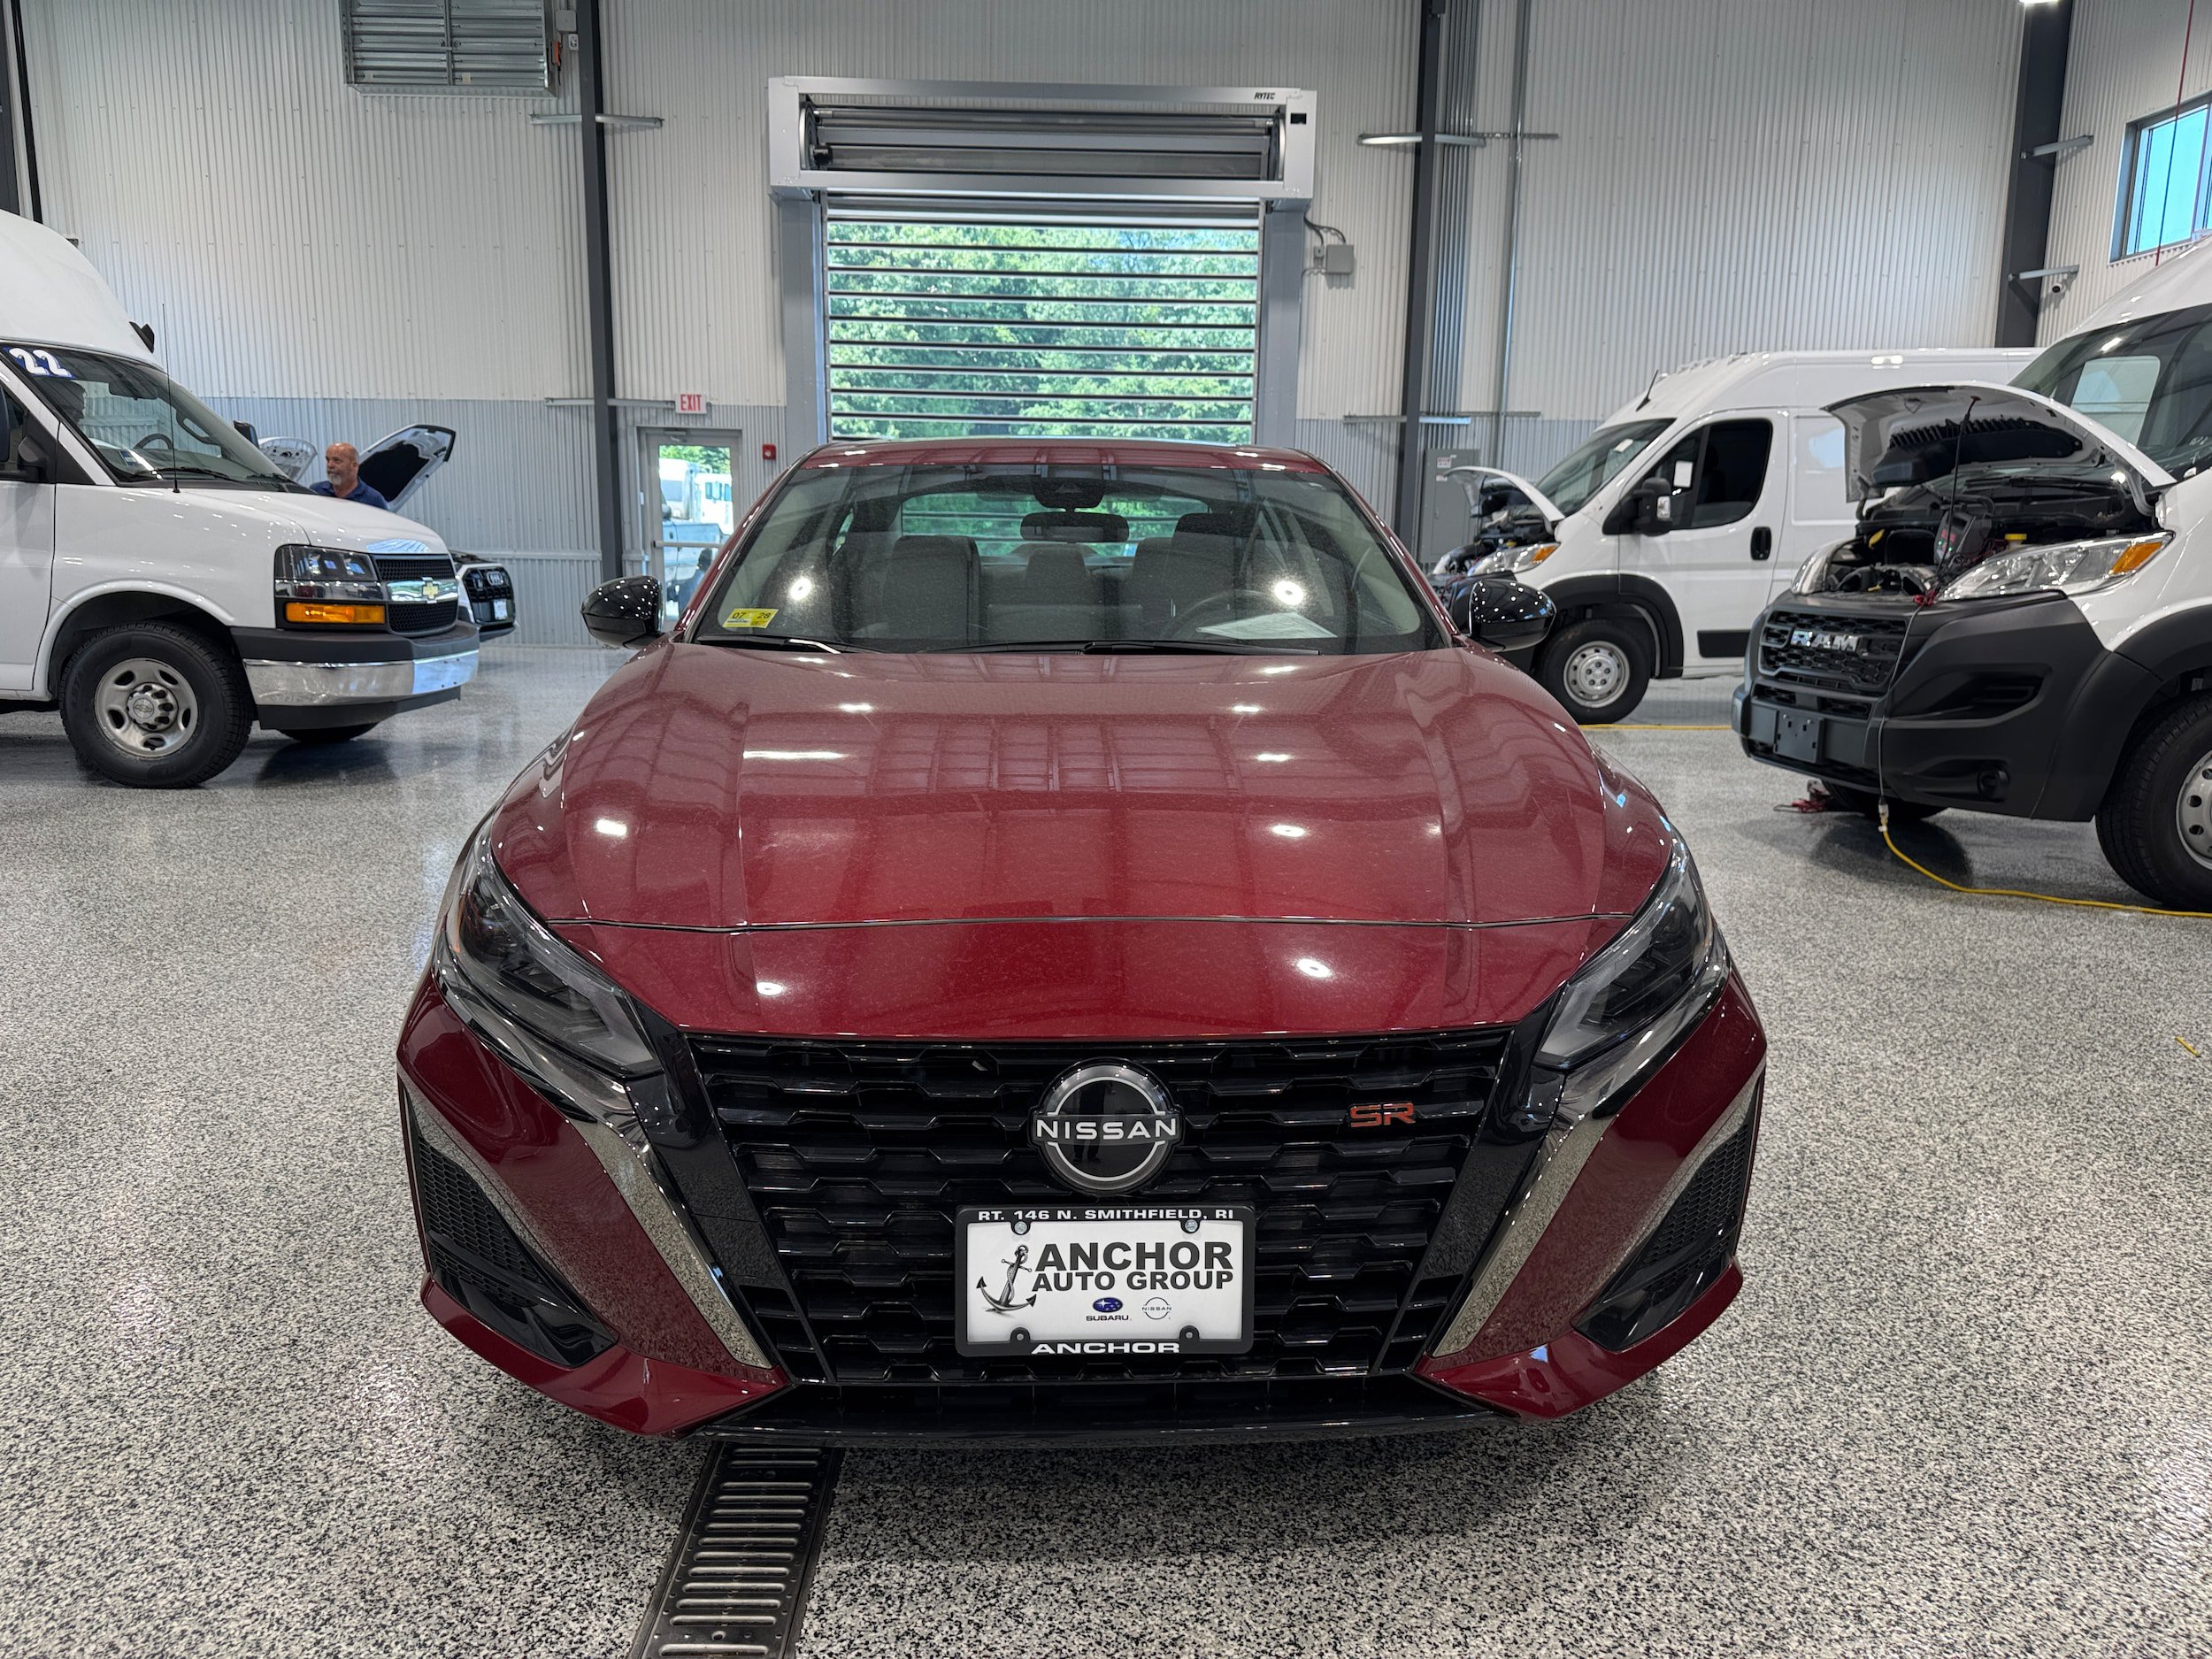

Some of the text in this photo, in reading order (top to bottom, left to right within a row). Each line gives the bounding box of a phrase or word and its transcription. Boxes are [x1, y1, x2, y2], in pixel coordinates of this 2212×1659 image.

[9, 348, 73, 376] 22
[680, 394, 702, 411] EXIT
[1790, 630, 1859, 651] RAM
[1349, 1102, 1416, 1128] SR
[1036, 1118, 1176, 1140] NISSAN
[978, 1209, 1234, 1221] RT. 146 N. SMITHFIELD, RI
[1035, 1241, 1233, 1271] ANCHOR
[1032, 1270, 1233, 1292] AUTO GROUP
[1031, 1342, 1180, 1355] ANCHOR
